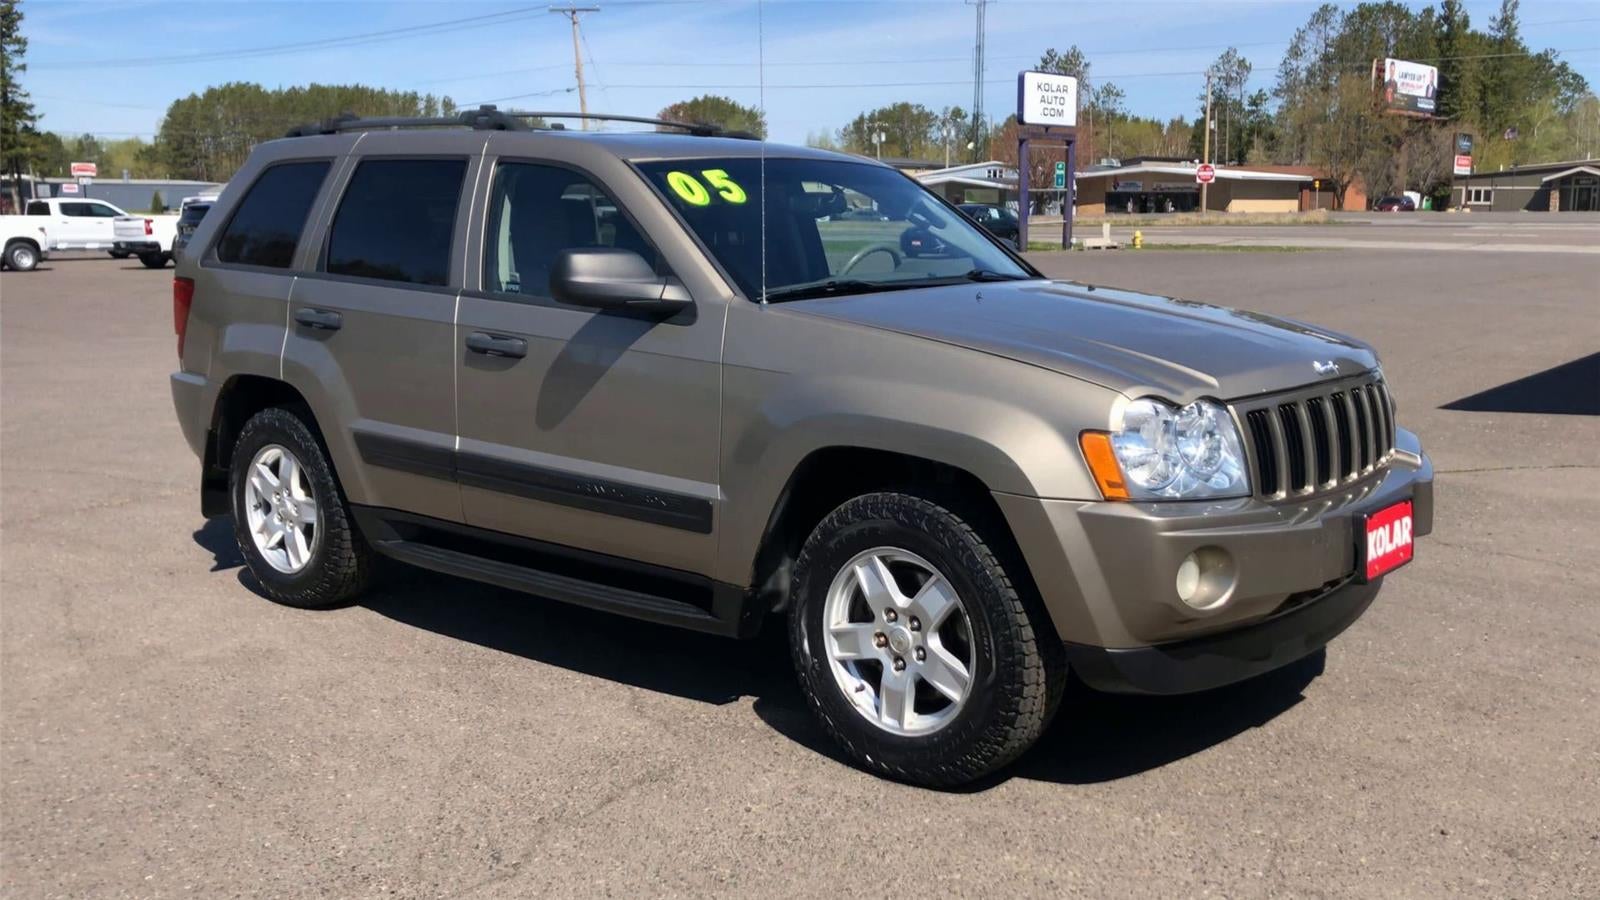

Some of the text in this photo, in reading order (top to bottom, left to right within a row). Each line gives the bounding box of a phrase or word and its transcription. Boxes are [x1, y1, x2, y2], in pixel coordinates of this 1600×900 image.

[1037, 82, 1068, 93] KOLAR
[1040, 95, 1065, 106] AUTO
[1040, 107, 1064, 117] .COM
[667, 170, 747, 206] 05
[1367, 516, 1412, 561] KOLAR
